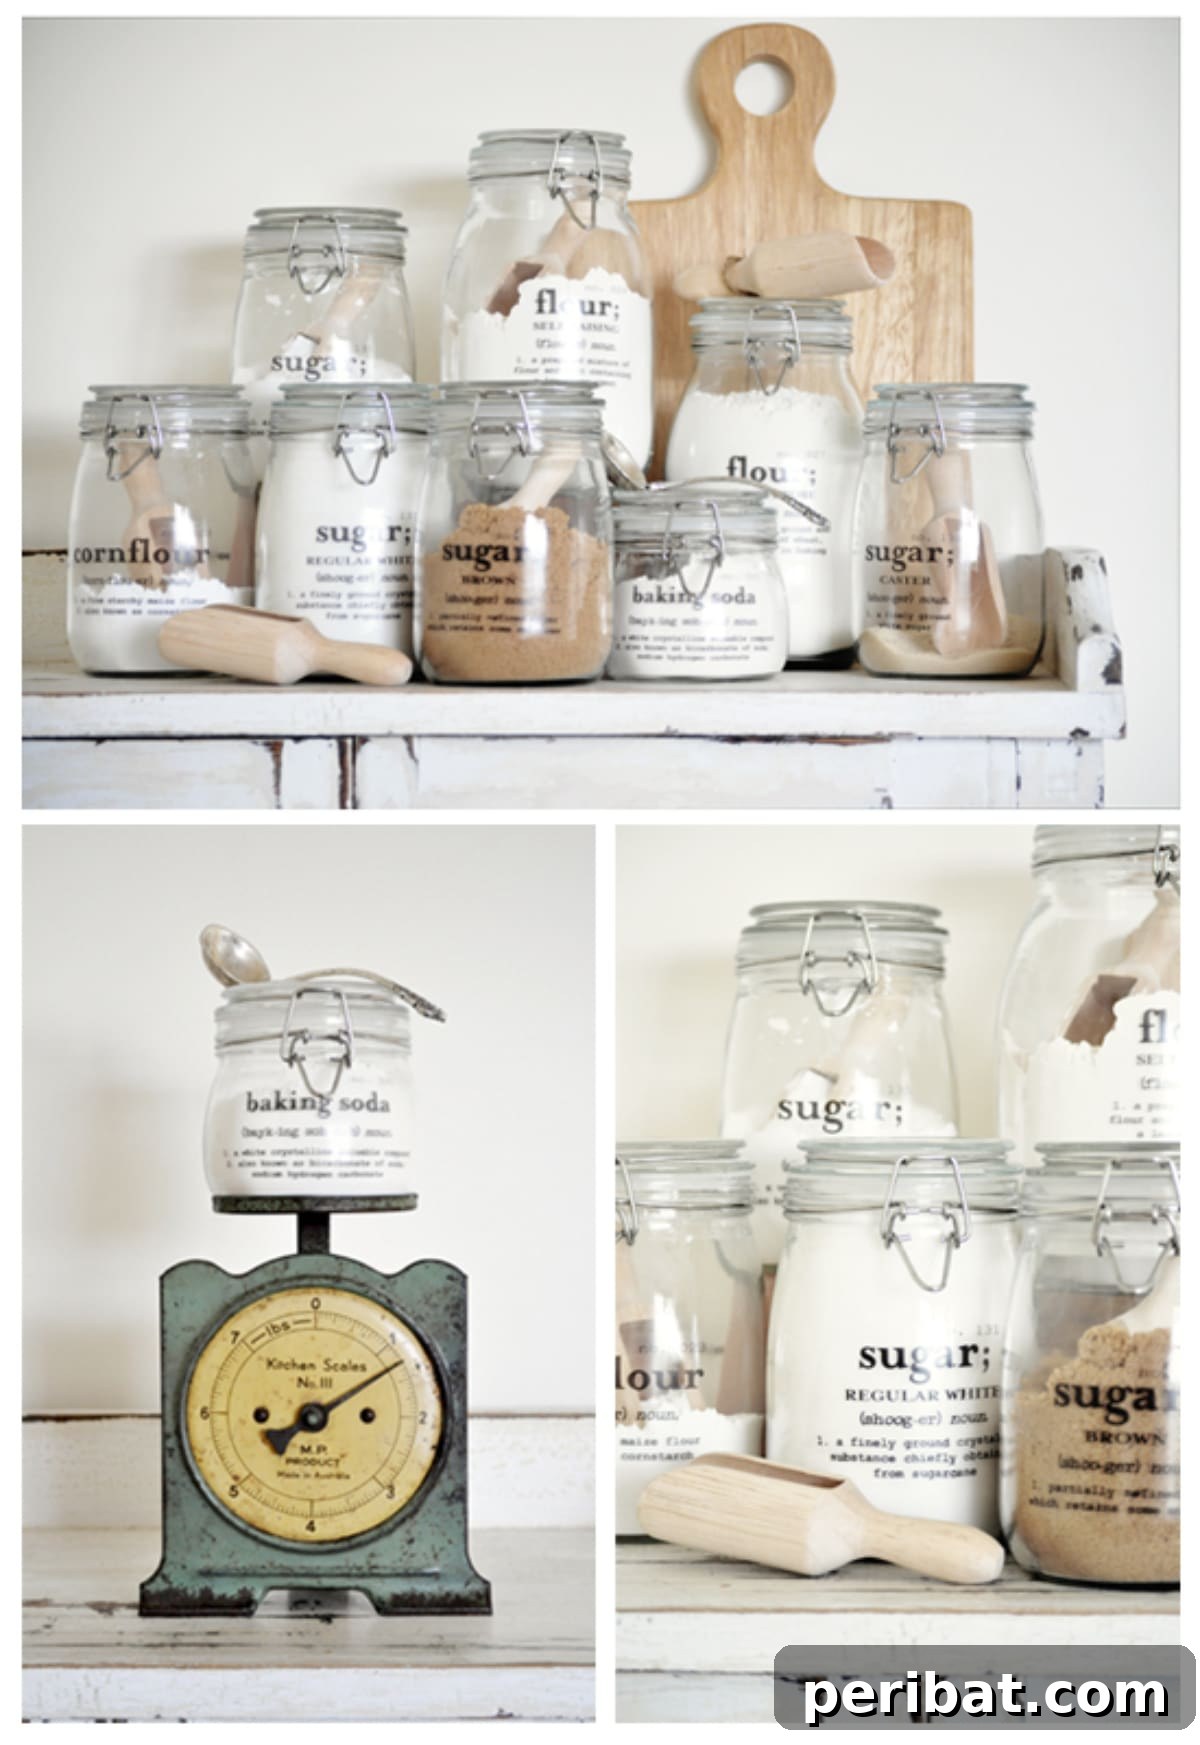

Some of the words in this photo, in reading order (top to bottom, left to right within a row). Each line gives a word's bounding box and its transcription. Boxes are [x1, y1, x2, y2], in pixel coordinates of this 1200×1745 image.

[534, 287, 619, 321] flur;
[726, 455, 817, 487] flou;
[315, 524, 412, 553] sugr;
[865, 544, 954, 572] sugar;
[632, 585, 705, 611] baking
[711, 585, 757, 605] soda
[246, 1091, 332, 1118] baking
[339, 1092, 391, 1113] soda
[310, 1298, 321, 1310] 0
[230, 1331, 241, 1345] 7
[266, 1321, 291, 1336] lbs
[323, 1358, 367, 1373] Scales
[858, 1343, 990, 1384] sugar;
[846, 1388, 939, 1401] REGULAR
[946, 1385, 1000, 1401] WHITE
[200, 1406, 211, 1420] 6
[418, 1411, 428, 1424] 2
[620, 1437, 658, 1446] maize
[851, 1437, 896, 1450] finely
[904, 1438, 951, 1450] ground
[1085, 1431, 1165, 1445] BROWN
[285, 1456, 341, 1467] PRODUCT
[830, 1452, 896, 1463] substance
[904, 1452, 956, 1465] chiefly
[873, 1468, 904, 1478] from
[912, 1468, 977, 1480] sugarcane
[229, 1484, 239, 1498] 5
[386, 1485, 396, 1499] 3
[1048, 1484, 1115, 1499] partially
[305, 1519, 317, 1534] 4
